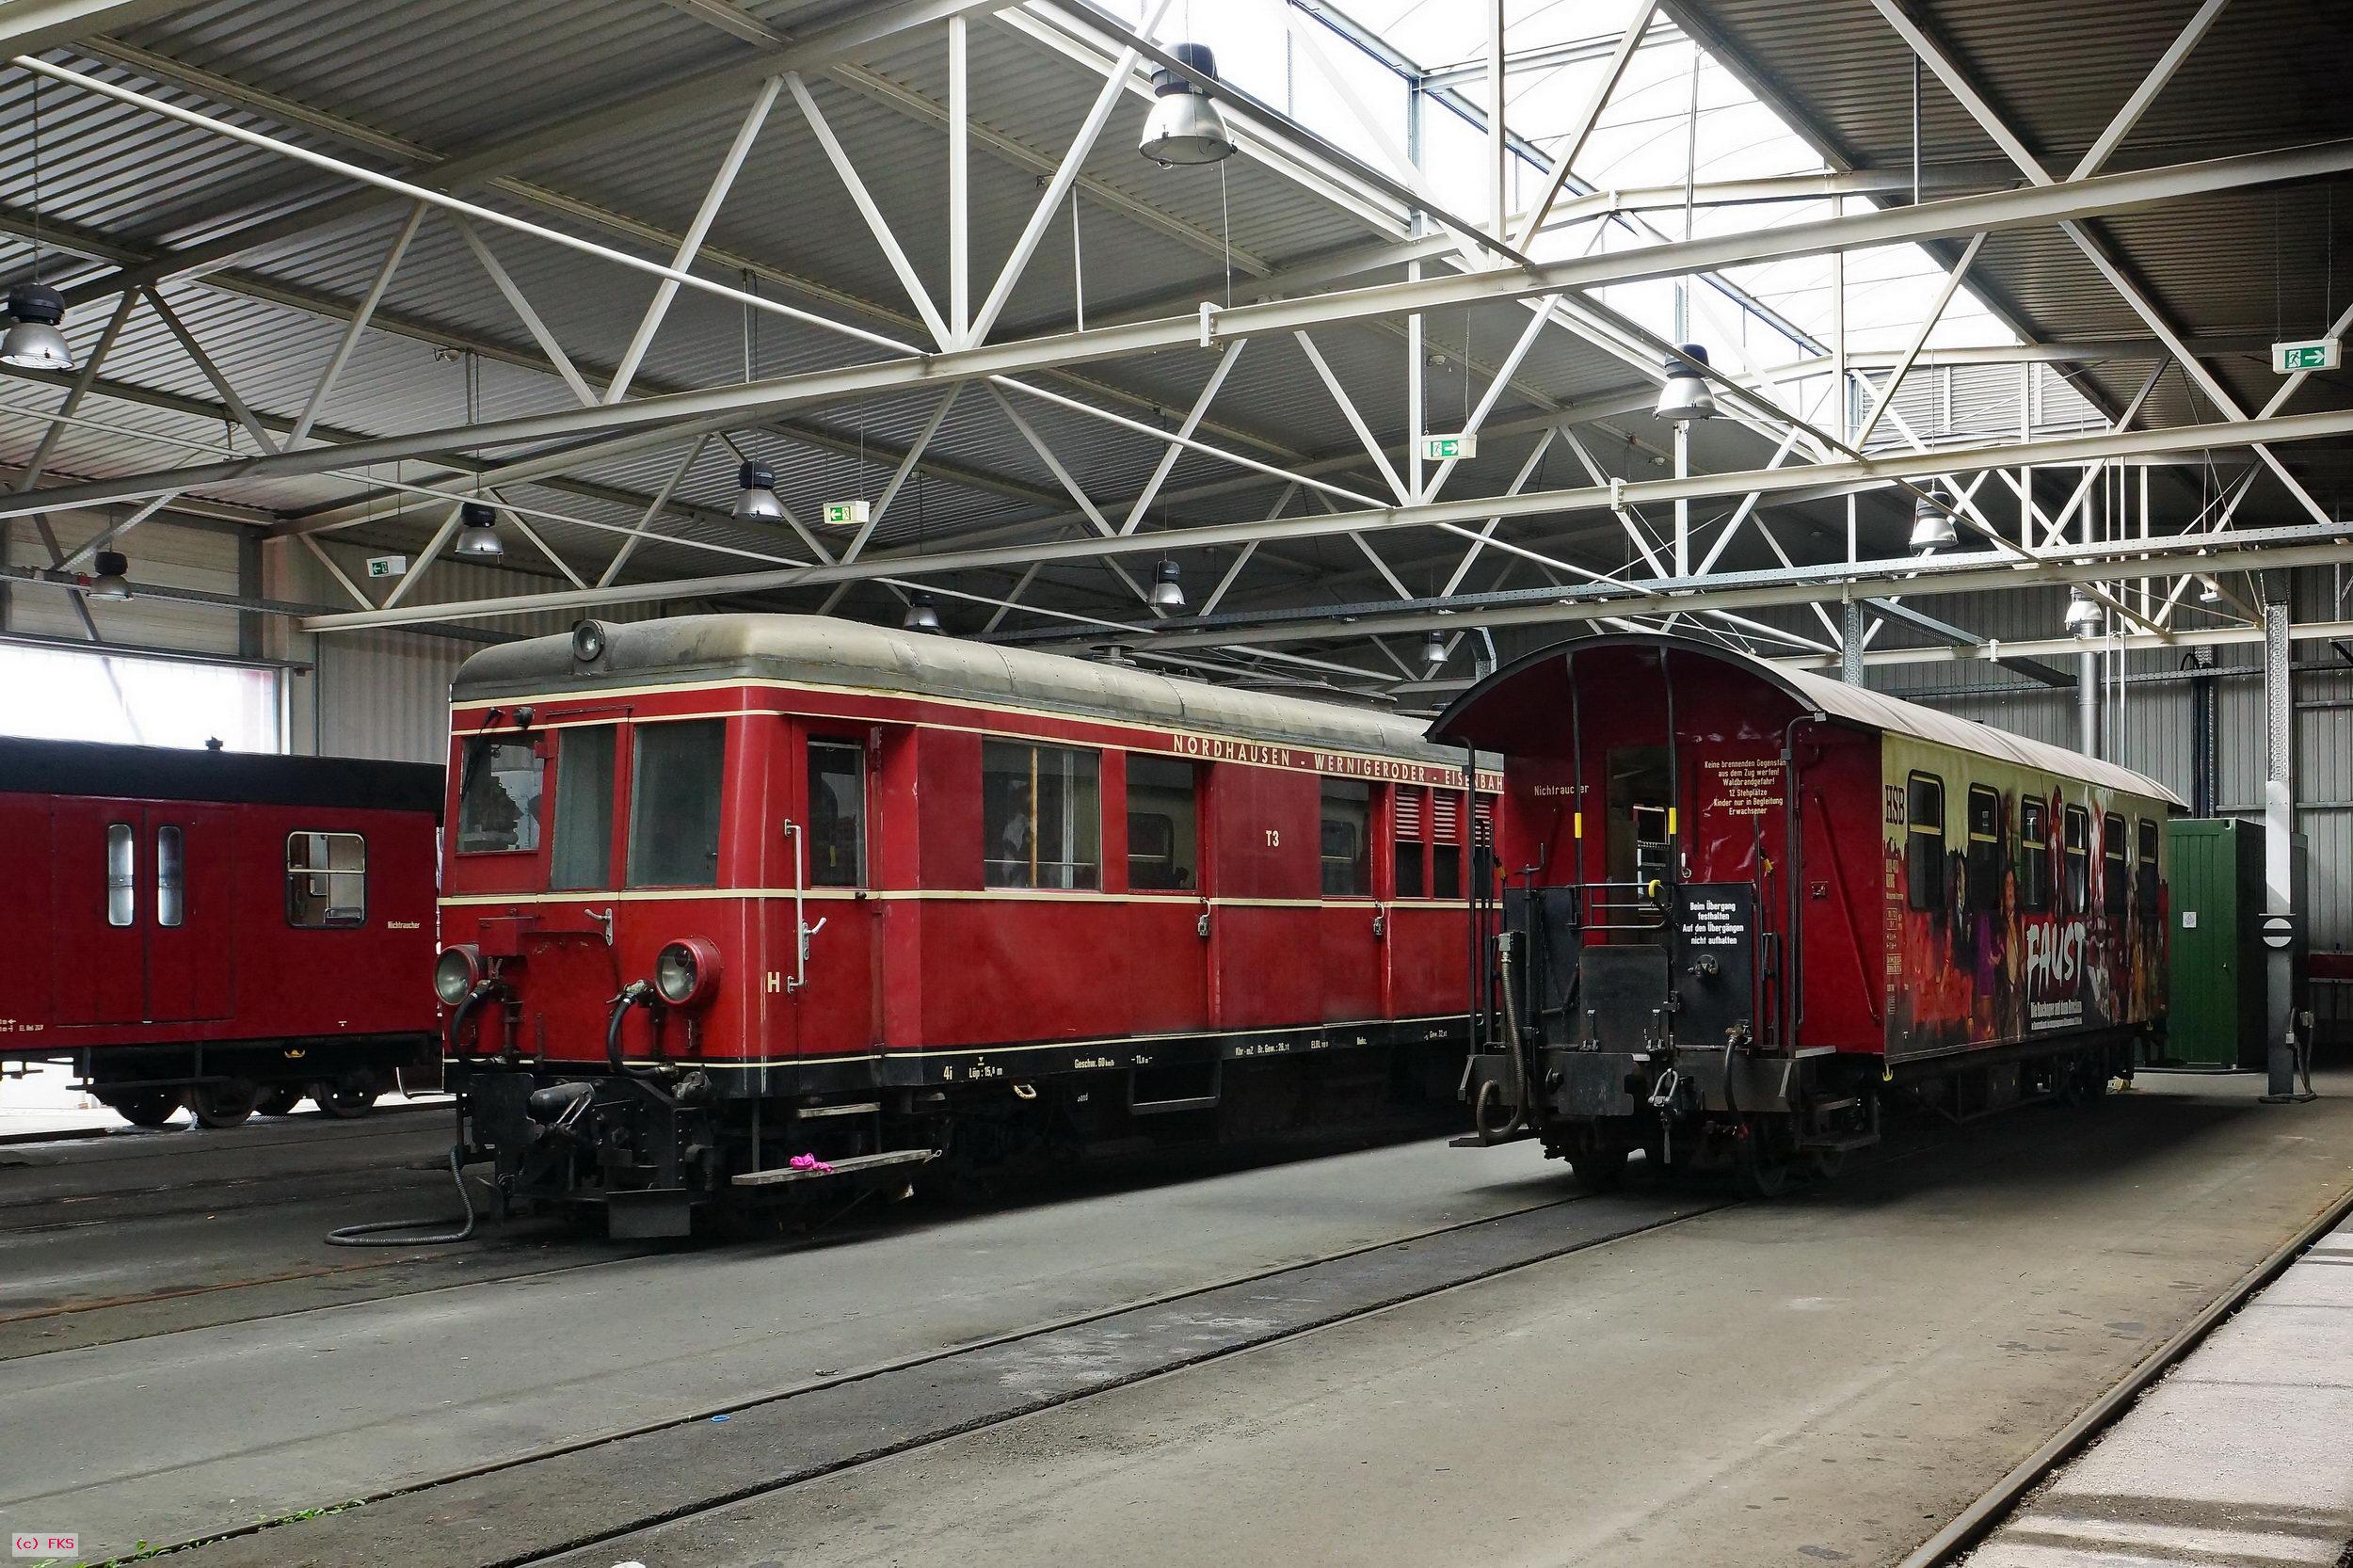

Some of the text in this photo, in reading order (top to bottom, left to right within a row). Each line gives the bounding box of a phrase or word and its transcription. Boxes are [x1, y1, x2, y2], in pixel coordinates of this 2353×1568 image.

[1173, 734, 1290, 767] NORDHAUSEN
[1314, 754, 1425, 782] WERNIGERODER
[1705, 760, 1720, 769] Keine
[1721, 760, 1755, 768] brennenden
[1744, 768, 1755, 777] Zug
[1756, 768, 1780, 776] werfen!
[1722, 777, 1775, 787] Waldbrandgefahr!
[1534, 785, 1590, 796] Nichtraucer
[1737, 789, 1768, 797] Stehplätze
[1713, 798, 1732, 807] Kinder
[1753, 797, 1784, 807] Begleitung
[1885, 785, 1905, 824] HSB
[1728, 808, 1768, 816] Erwachsener
[1265, 829, 1280, 847] T3
[1689, 900, 1736, 912] Beim Übergang
[1698, 912, 1730, 920] festhalten
[1682, 921, 1744, 934] Auf den Übergängen
[1690, 936, 1737, 945] nicht aufhalten
[2026, 921, 2086, 1001] FAUST
[767, 971, 780, 993] H
[1074, 1058, 1097, 1069] Geschw.
[943, 1065, 952, 1080] 4i
